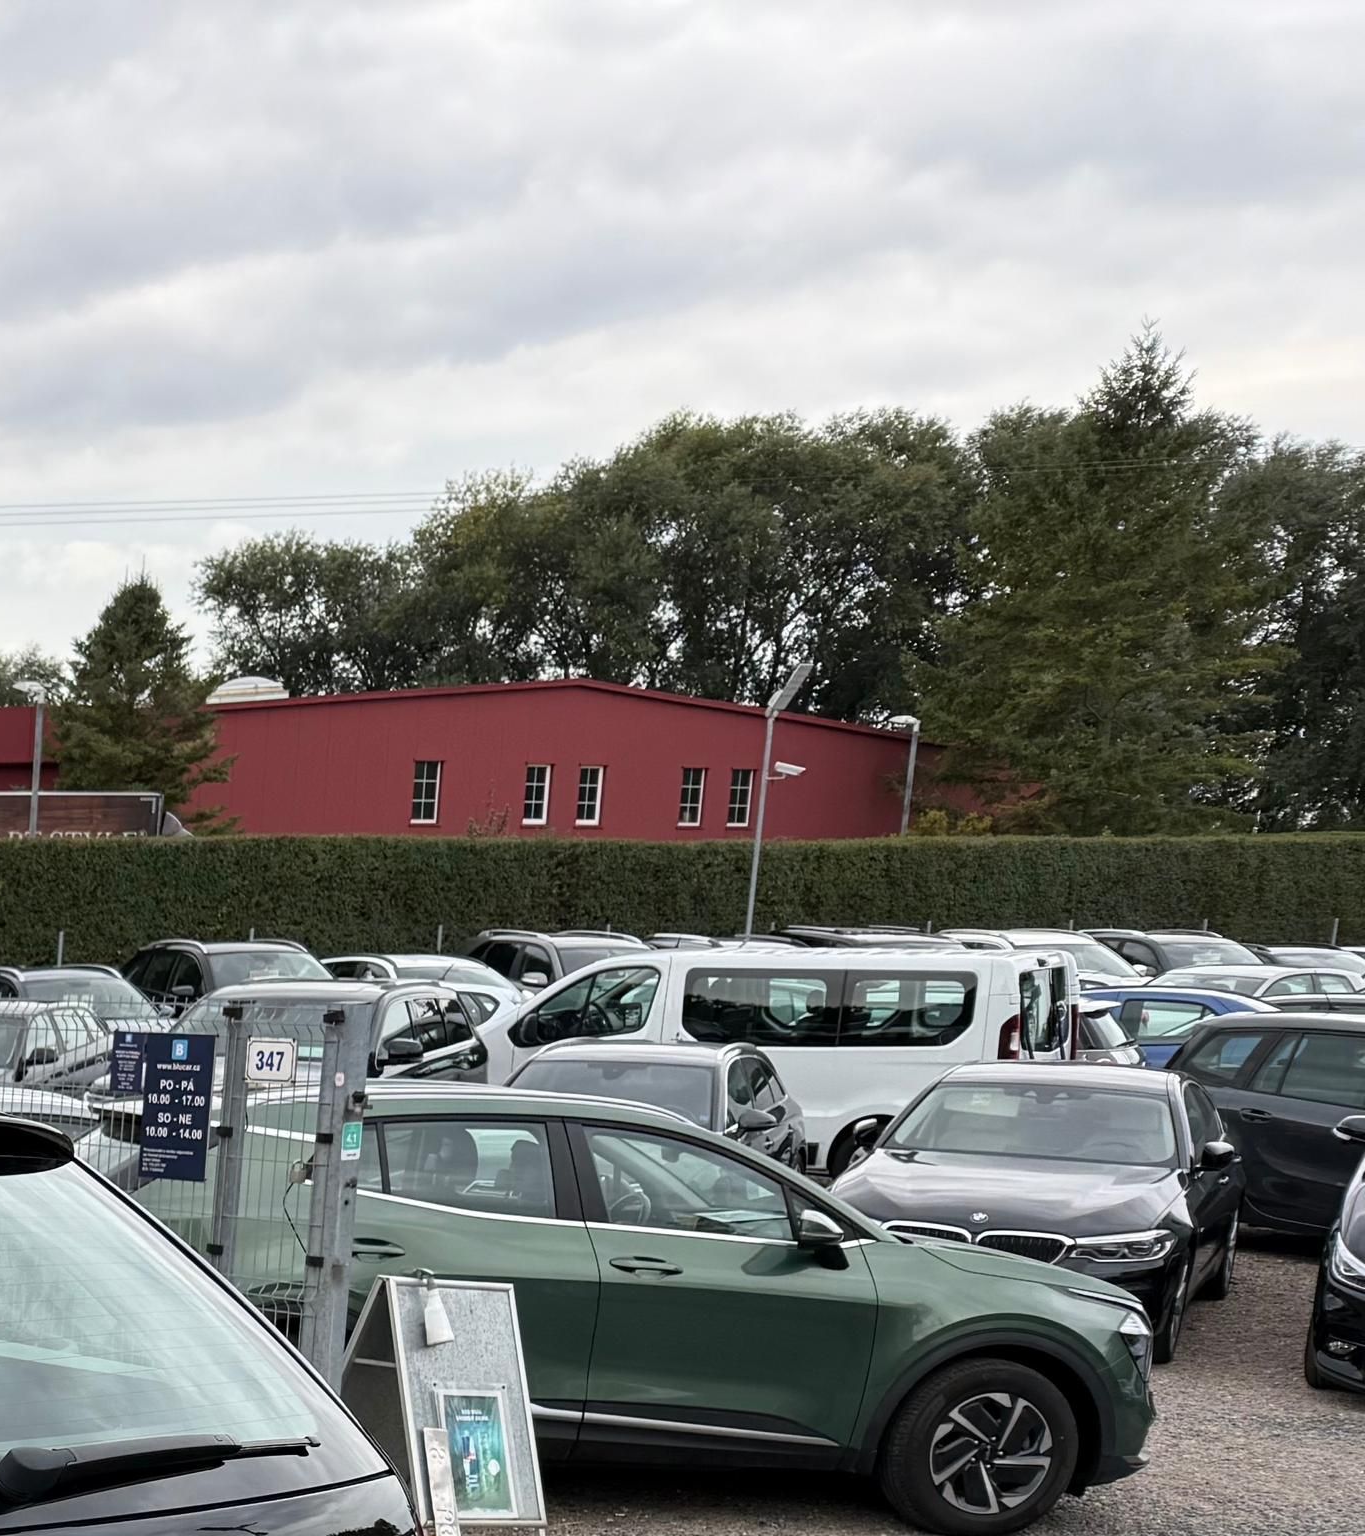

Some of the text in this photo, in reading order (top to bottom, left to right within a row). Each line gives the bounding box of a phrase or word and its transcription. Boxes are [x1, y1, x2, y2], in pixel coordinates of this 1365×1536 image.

[255, 1050, 284, 1072] 347
[159, 1079, 174, 1091] PO
[181, 1078, 195, 1092] PÁ
[147, 1093, 171, 1105] 10.00
[182, 1095, 205, 1107] 17.00
[157, 1112, 172, 1124] SO
[178, 1113, 193, 1125] NE
[145, 1126, 168, 1138] 10.00
[179, 1128, 203, 1140] 14.00
